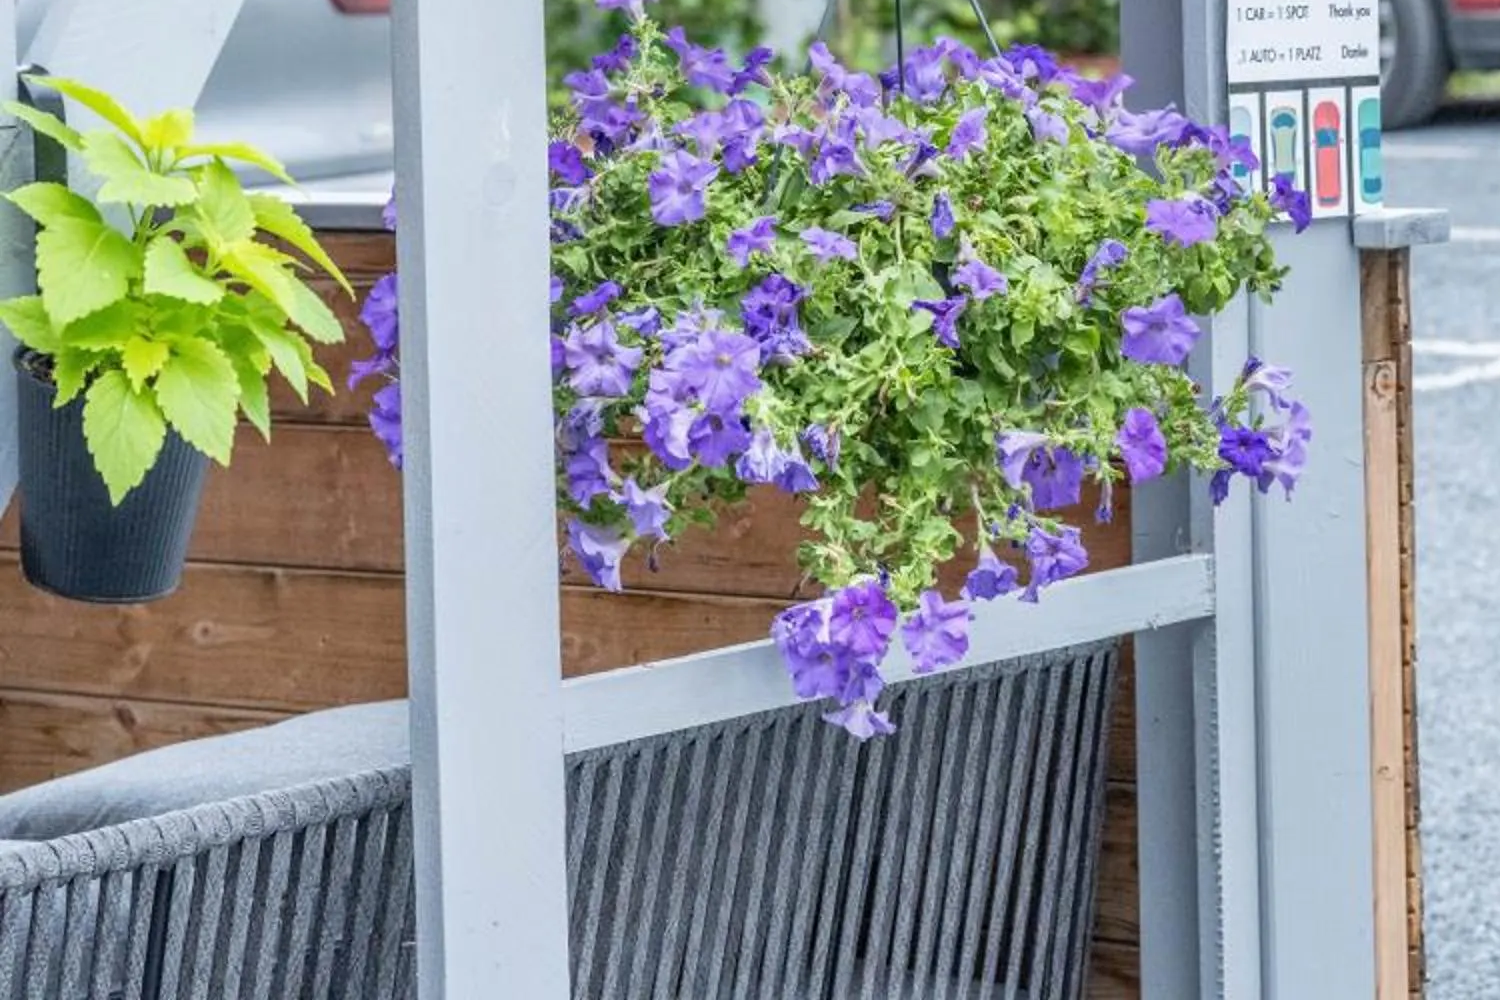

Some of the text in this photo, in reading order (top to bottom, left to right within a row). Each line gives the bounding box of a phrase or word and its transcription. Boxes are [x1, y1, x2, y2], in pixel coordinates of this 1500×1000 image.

[1237, 7, 1242, 21] 1
[1245, 7, 1265, 20] CAR
[1285, 5, 1309, 19] SPOT
[1329, 2, 1352, 18] Thank
[1355, 8, 1371, 20] you
[1249, 48, 1276, 62] AUTO
[1295, 46, 1322, 61] PLATZ
[1341, 44, 1368, 60] Danke
